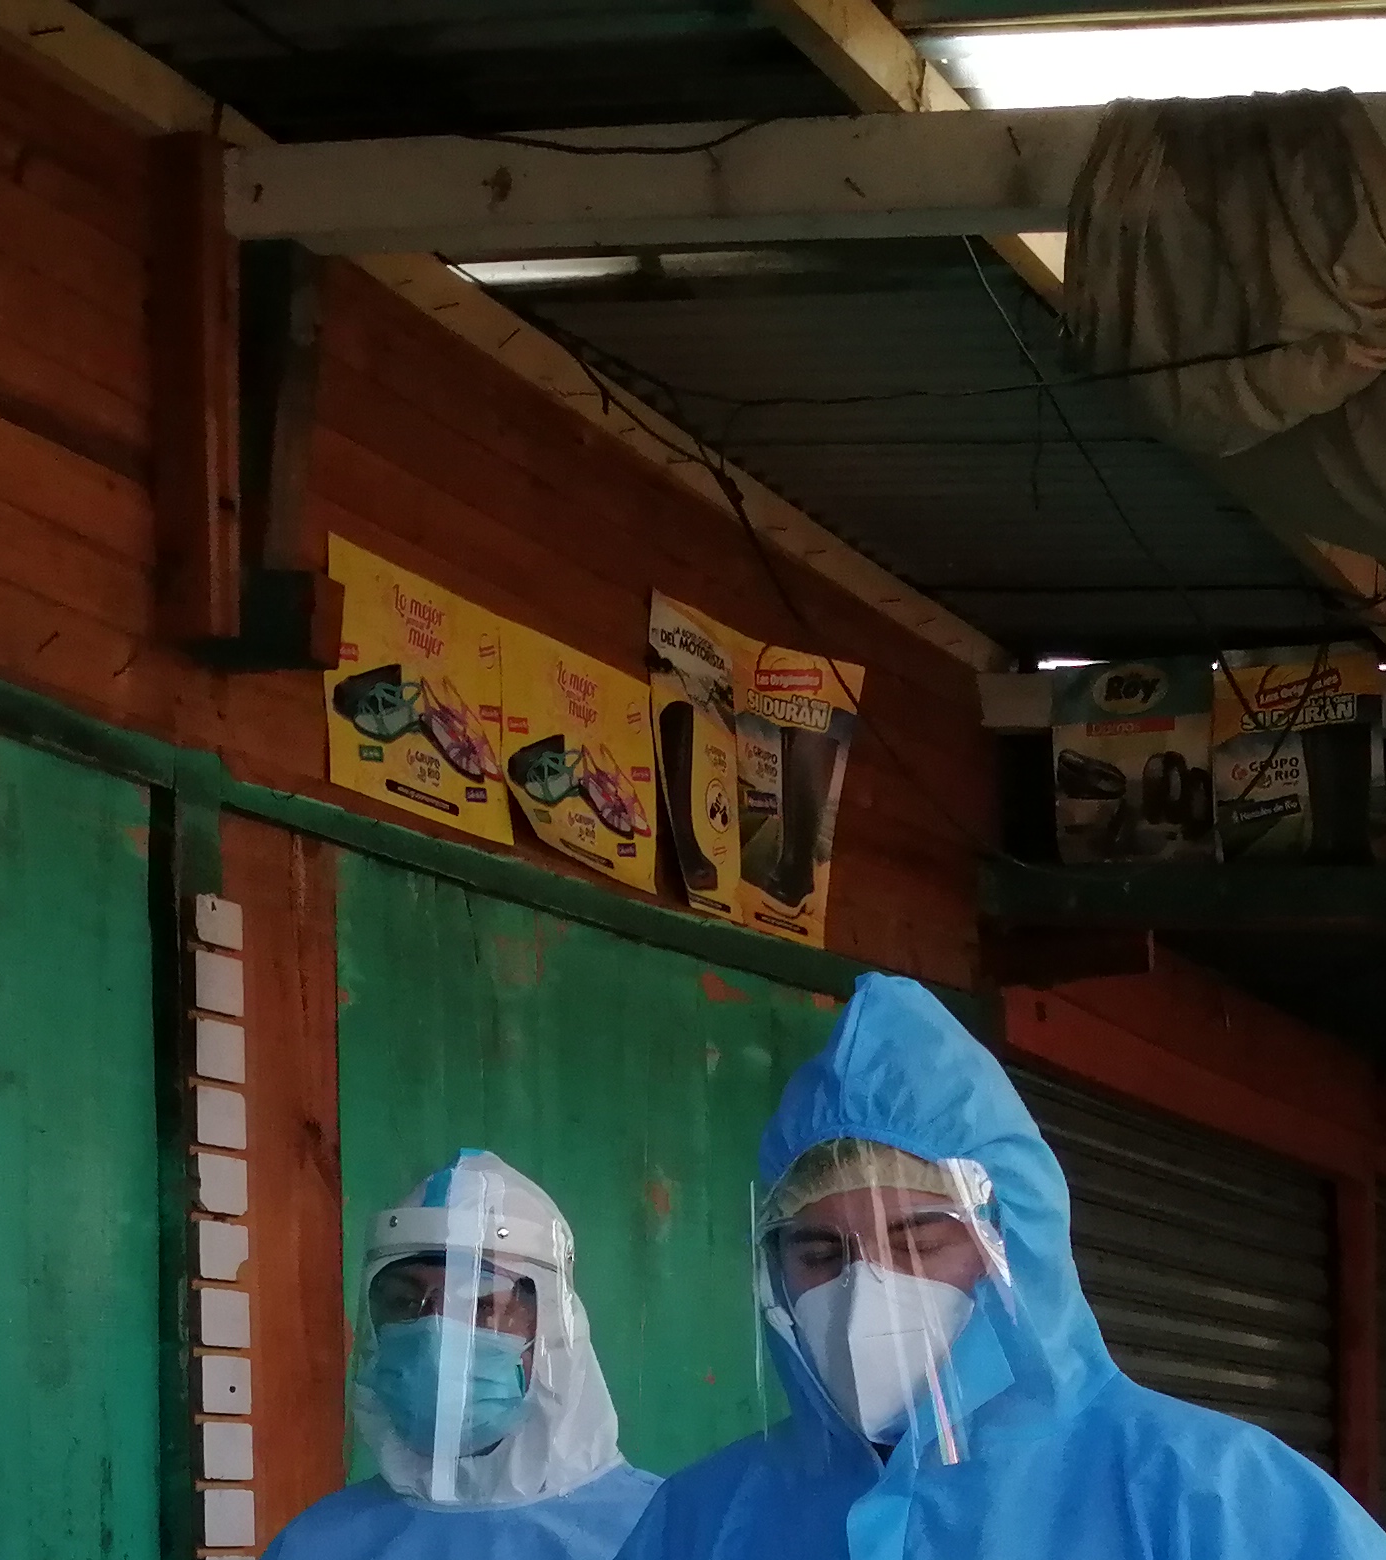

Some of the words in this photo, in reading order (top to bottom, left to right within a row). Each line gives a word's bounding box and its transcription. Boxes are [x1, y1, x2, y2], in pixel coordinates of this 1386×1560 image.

[410, 599, 446, 630] mejor
[408, 628, 445, 659] mujer
[568, 700, 598, 728] mujer
[1274, 768, 1300, 781] RIO
